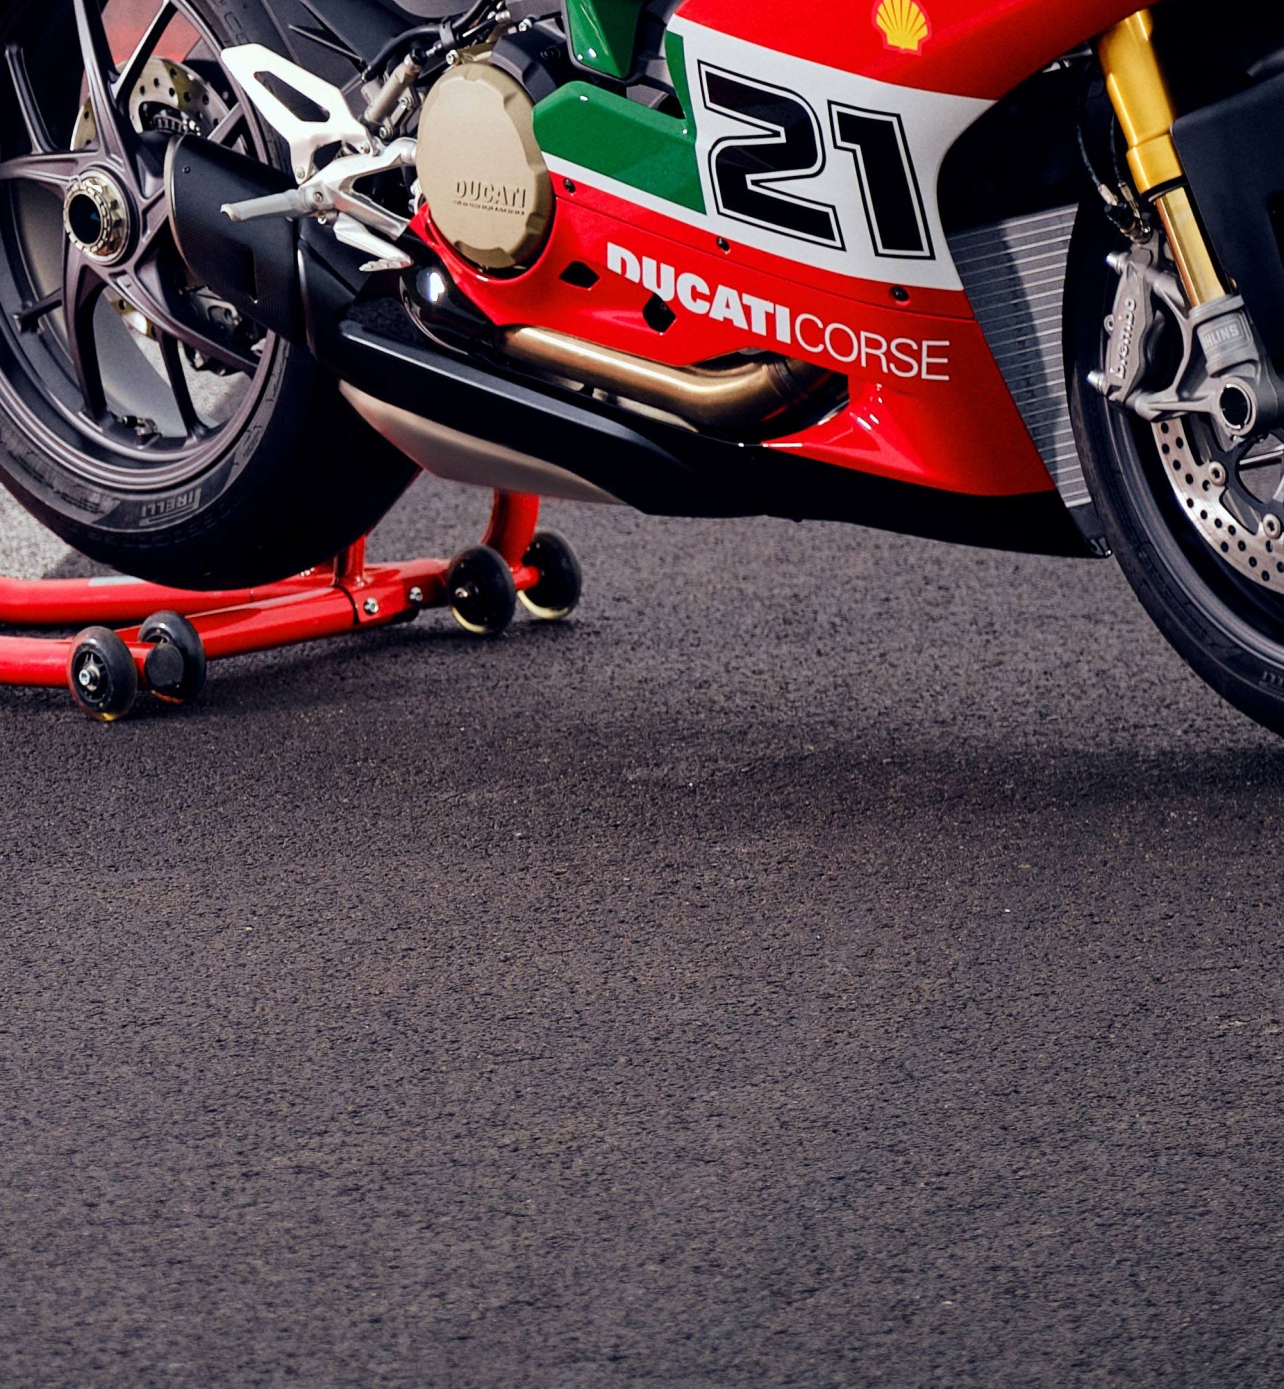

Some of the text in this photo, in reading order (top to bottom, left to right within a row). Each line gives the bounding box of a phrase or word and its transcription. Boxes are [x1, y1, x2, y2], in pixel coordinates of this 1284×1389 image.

[697, 59, 936, 260] 21
[453, 179, 527, 209] DUCATI
[138, 488, 202, 527] PIRELLI
